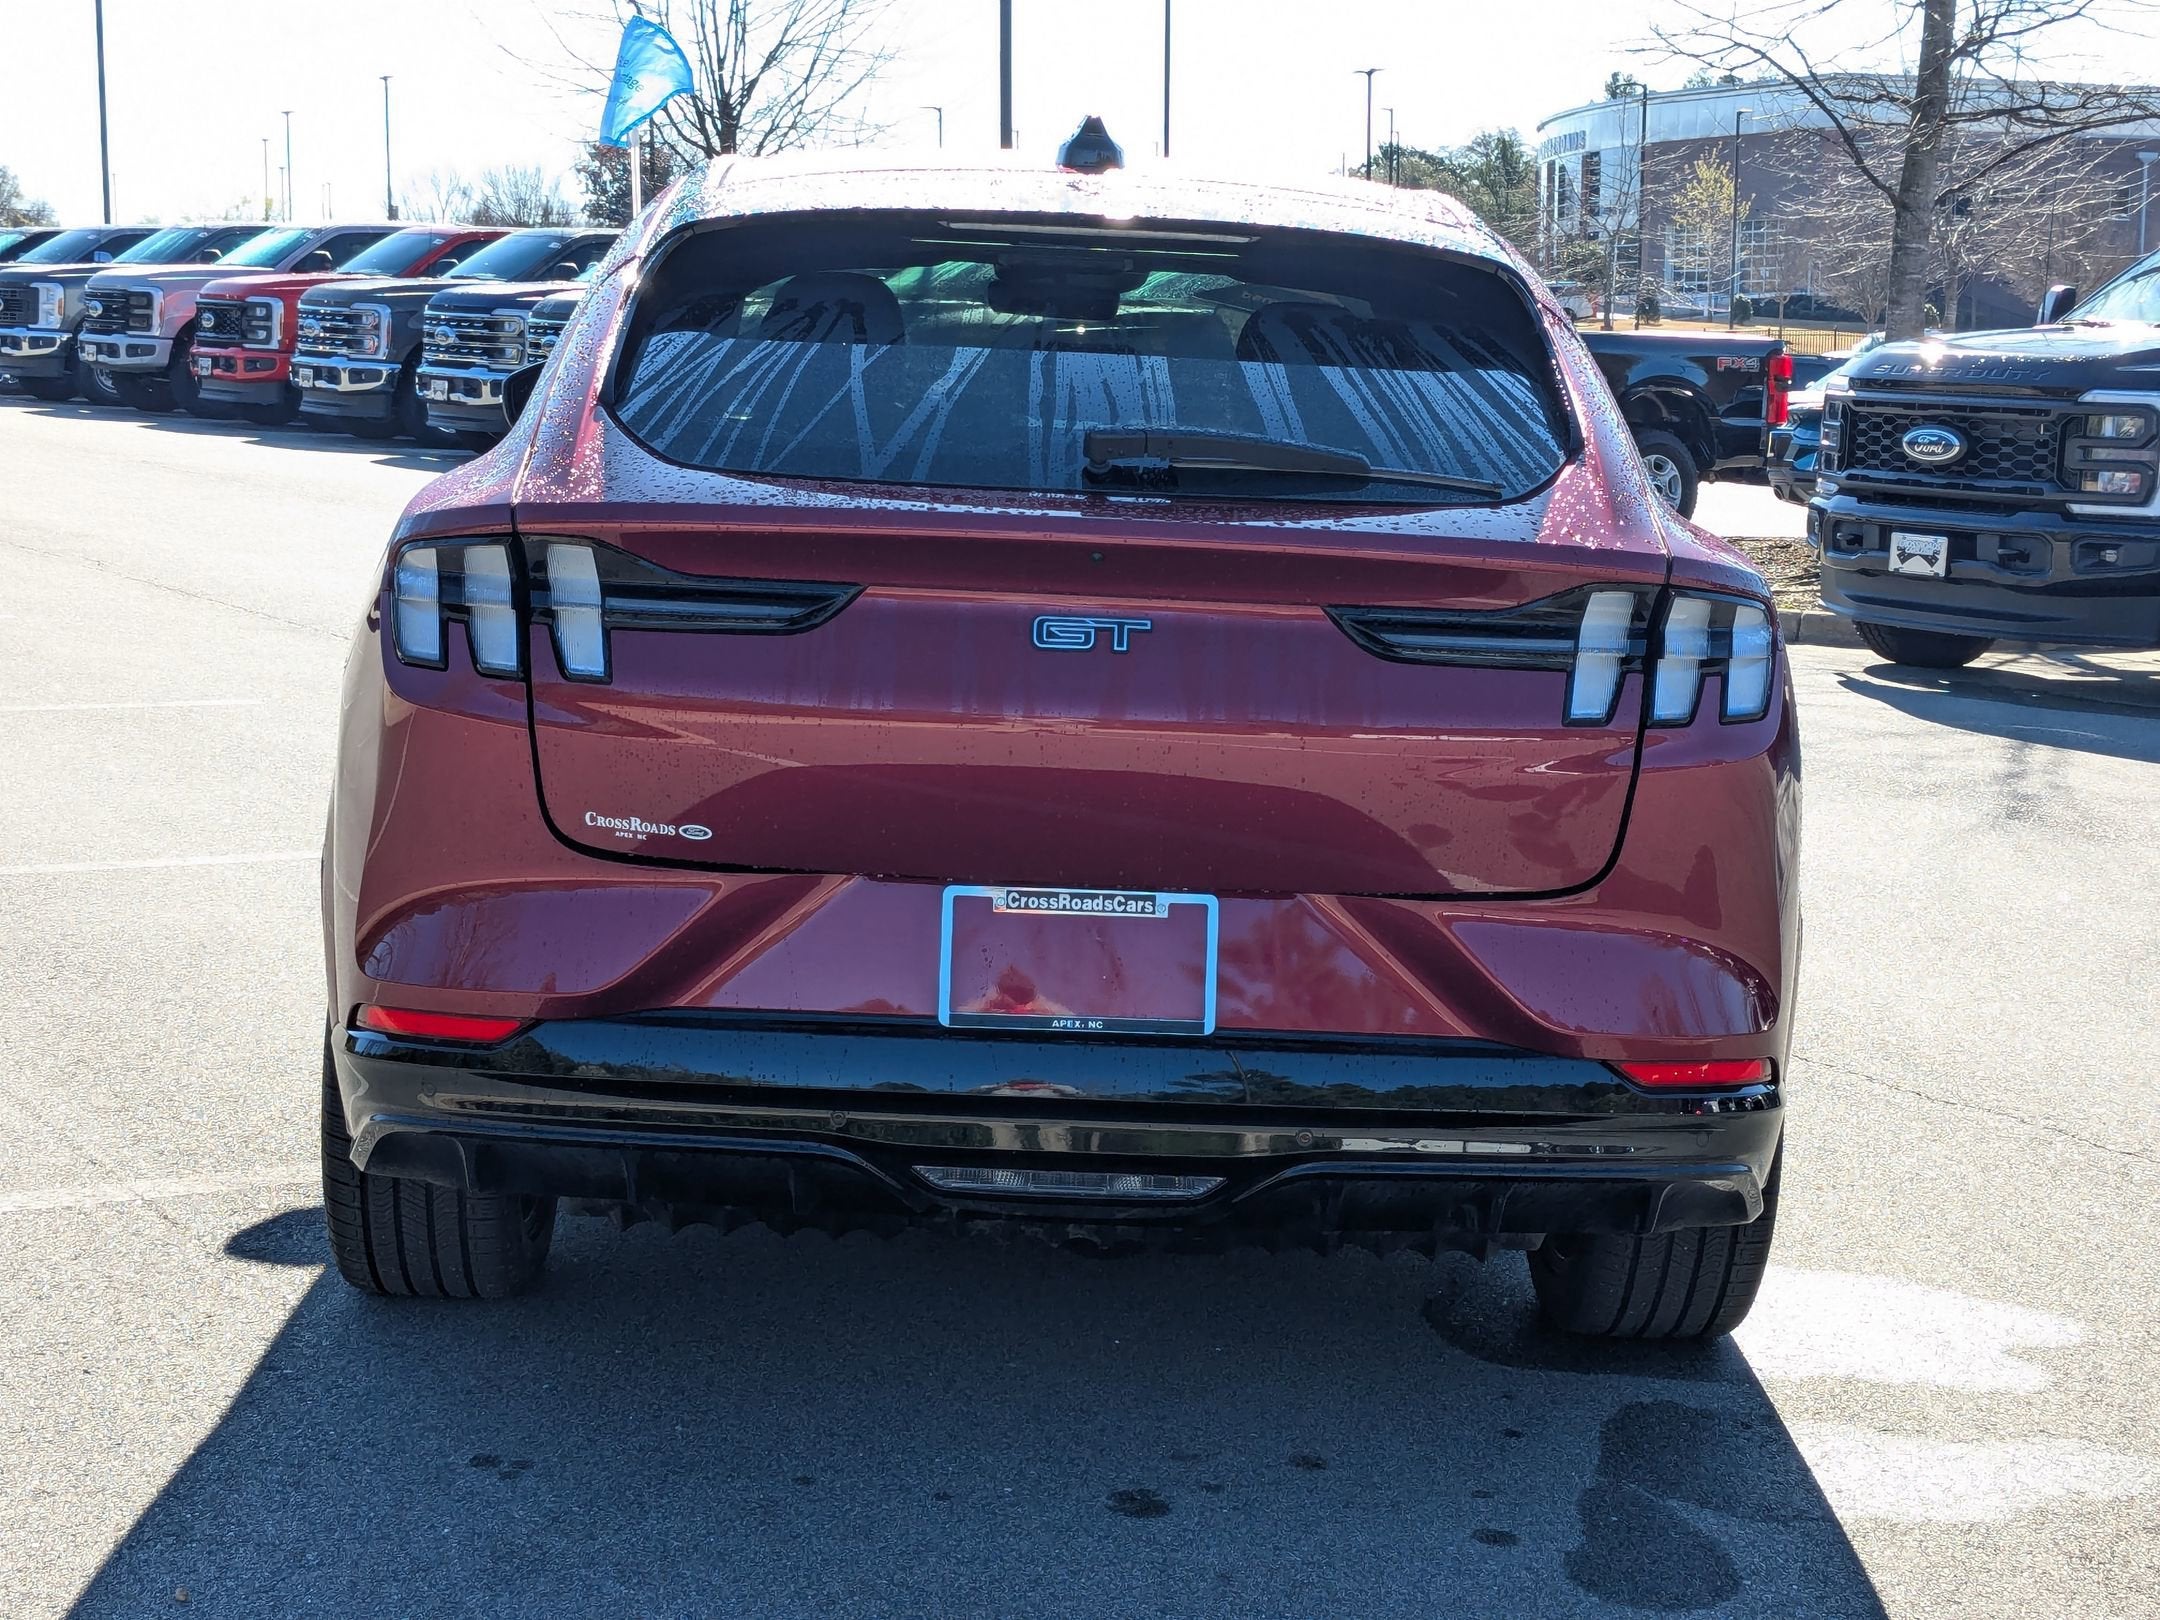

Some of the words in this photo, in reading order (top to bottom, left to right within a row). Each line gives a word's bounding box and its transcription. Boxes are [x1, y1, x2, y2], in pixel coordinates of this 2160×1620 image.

[1717, 356, 1760, 372] FX4
[1965, 366, 2051, 380] DUTY
[1914, 435, 1946, 454] Ford
[1033, 615, 1151, 652] GT
[1007, 891, 1154, 913] CrossRoadsCars
[1088, 1020, 1103, 1029] NC
